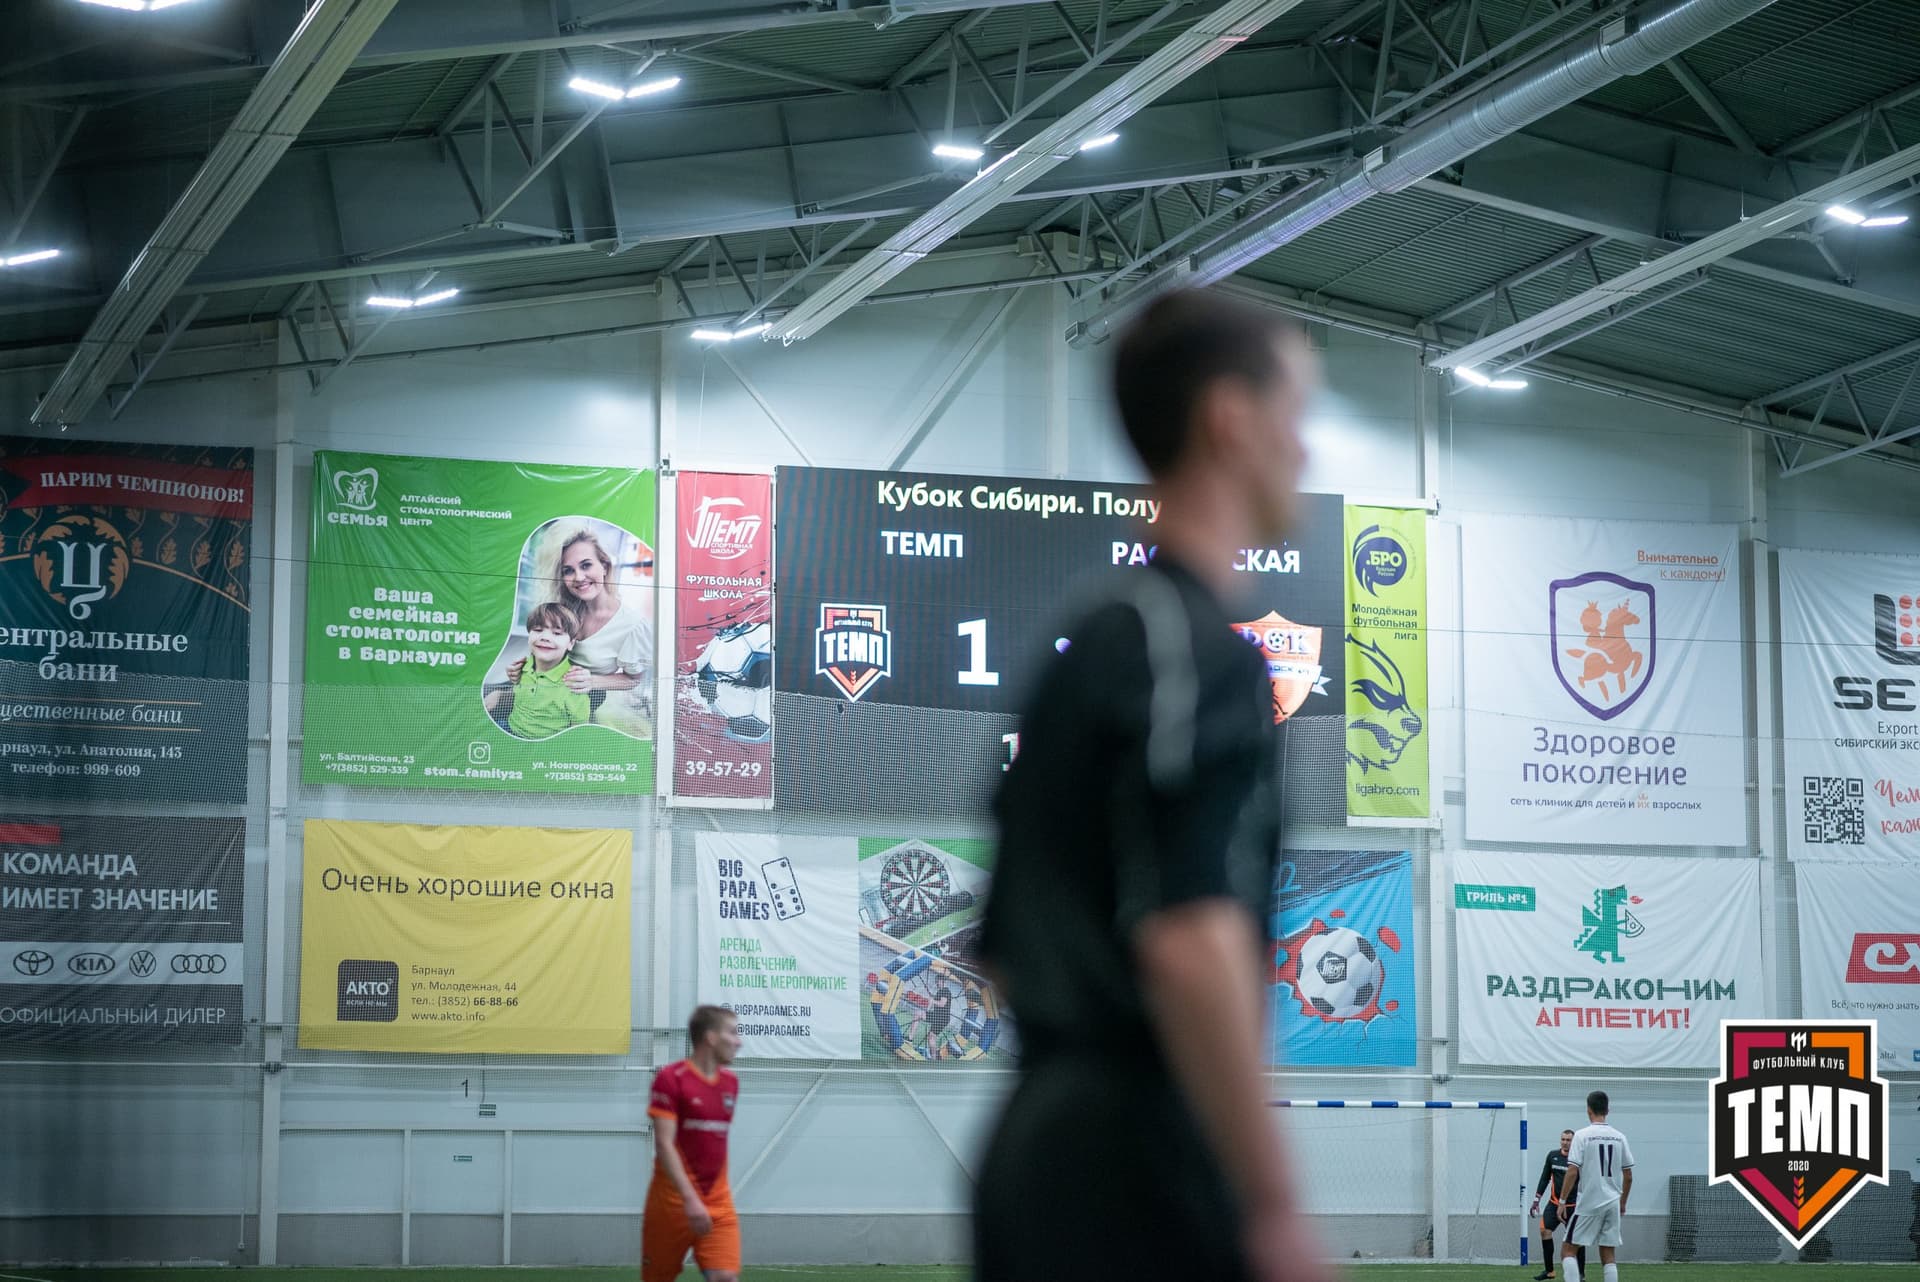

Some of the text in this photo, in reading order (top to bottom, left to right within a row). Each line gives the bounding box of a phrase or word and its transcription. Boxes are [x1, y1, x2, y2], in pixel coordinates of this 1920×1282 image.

[40, 472, 244, 503] ПАРИМ ЧЕМПИОНОВ!
[400, 494, 461, 505] АЛТАЙСКИЙ
[878, 480, 963, 511] Кубок
[970, 486, 1084, 518] Сибири.
[400, 506, 512, 519] СТОМАТОЛОГИЧЕСКИЙ
[400, 518, 432, 527] ЦЕНТР
[881, 530, 963, 558] ТЕМП
[1637, 550, 1719, 564] Внимательно
[686, 575, 762, 586] ФУТБОЛЬНАЯ
[1661, 568, 1726, 582] к каждому!
[374, 587, 433, 604] Ваша
[704, 588, 743, 599] ШКОЛА
[349, 605, 458, 624] семейная
[1352, 603, 1417, 617] Молодёжная
[1354, 616, 1417, 628] футбольная
[326, 624, 480, 644] стоматология
[1394, 632, 1417, 641] лига
[360, 646, 467, 667] Барнауле
[824, 632, 883, 666] ТЕМП
[957, 619, 999, 686] 1
[39, 655, 119, 682] бани
[132, 704, 184, 724] бани
[1878, 721, 1919, 737] Export
[1534, 726, 1676, 757] Здоровое
[1835, 737, 1897, 750] СИБИРСКИЙ
[54, 744, 76, 757] ул.
[80, 744, 156, 760] Анатолия,
[337, 753, 400, 764] Балтийская,
[12, 762, 141, 777] телефон: 999-609
[326, 763, 367, 773] +7(3852)
[532, 761, 546, 770] ул.
[686, 761, 761, 776] 39-57-29
[424, 767, 522, 781] stom_family22
[1523, 762, 1687, 786] поколение
[1354, 784, 1420, 801] ligabro.com
[1510, 797, 1532, 807] сеть
[1535, 799, 1573, 808] клиник
[1575, 799, 1593, 809] для
[1595, 797, 1626, 809] детей
[1628, 801, 1635, 809] и
[1652, 801, 1702, 811] взрослых
[4, 853, 137, 880] КОМАНДА
[719, 859, 743, 878] BIG
[322, 868, 614, 901] Очень хорошие окна
[719, 879, 757, 899] PAPA
[3, 887, 218, 910] ИМЕЕТ ЗНАЧЕНИЕ
[1467, 891, 1528, 905] ГРИЛЬ №1
[719, 901, 770, 921] GAMES
[720, 937, 762, 953] АРЕНДА
[411, 965, 455, 977] Барнаул
[720, 955, 797, 971] РАЗВЛЕЧЕНИЙ
[346, 981, 390, 996] АКТО
[411, 982, 426, 992] ул.
[504, 982, 517, 992] 44
[720, 974, 847, 990] НА ВАШЕ МЕРОПРИЯТИЕ
[1486, 975, 1736, 1004] РАЗДРАКОНИМ
[438, 996, 470, 1007] (3852)
[473, 997, 519, 1007] 66-88-66
[1851, 1001, 1865, 1009] что
[1867, 1001, 1894, 1011] нужно
[1896, 1002, 1920, 1010] знать
[0, 1003, 226, 1027] ОФИЦИАЛЬНЫЙ ДИЛЕР
[411, 1011, 486, 1022] www.akto.info
[735, 1004, 811, 1017] BIGPAPAGAMES.RU
[1536, 1007, 1690, 1029] АППЕТИТ!
[737, 1024, 810, 1037] @BIGPAPAGAMES
[461, 1079, 468, 1098] 1
[1599, 1144, 1613, 1177] 11
